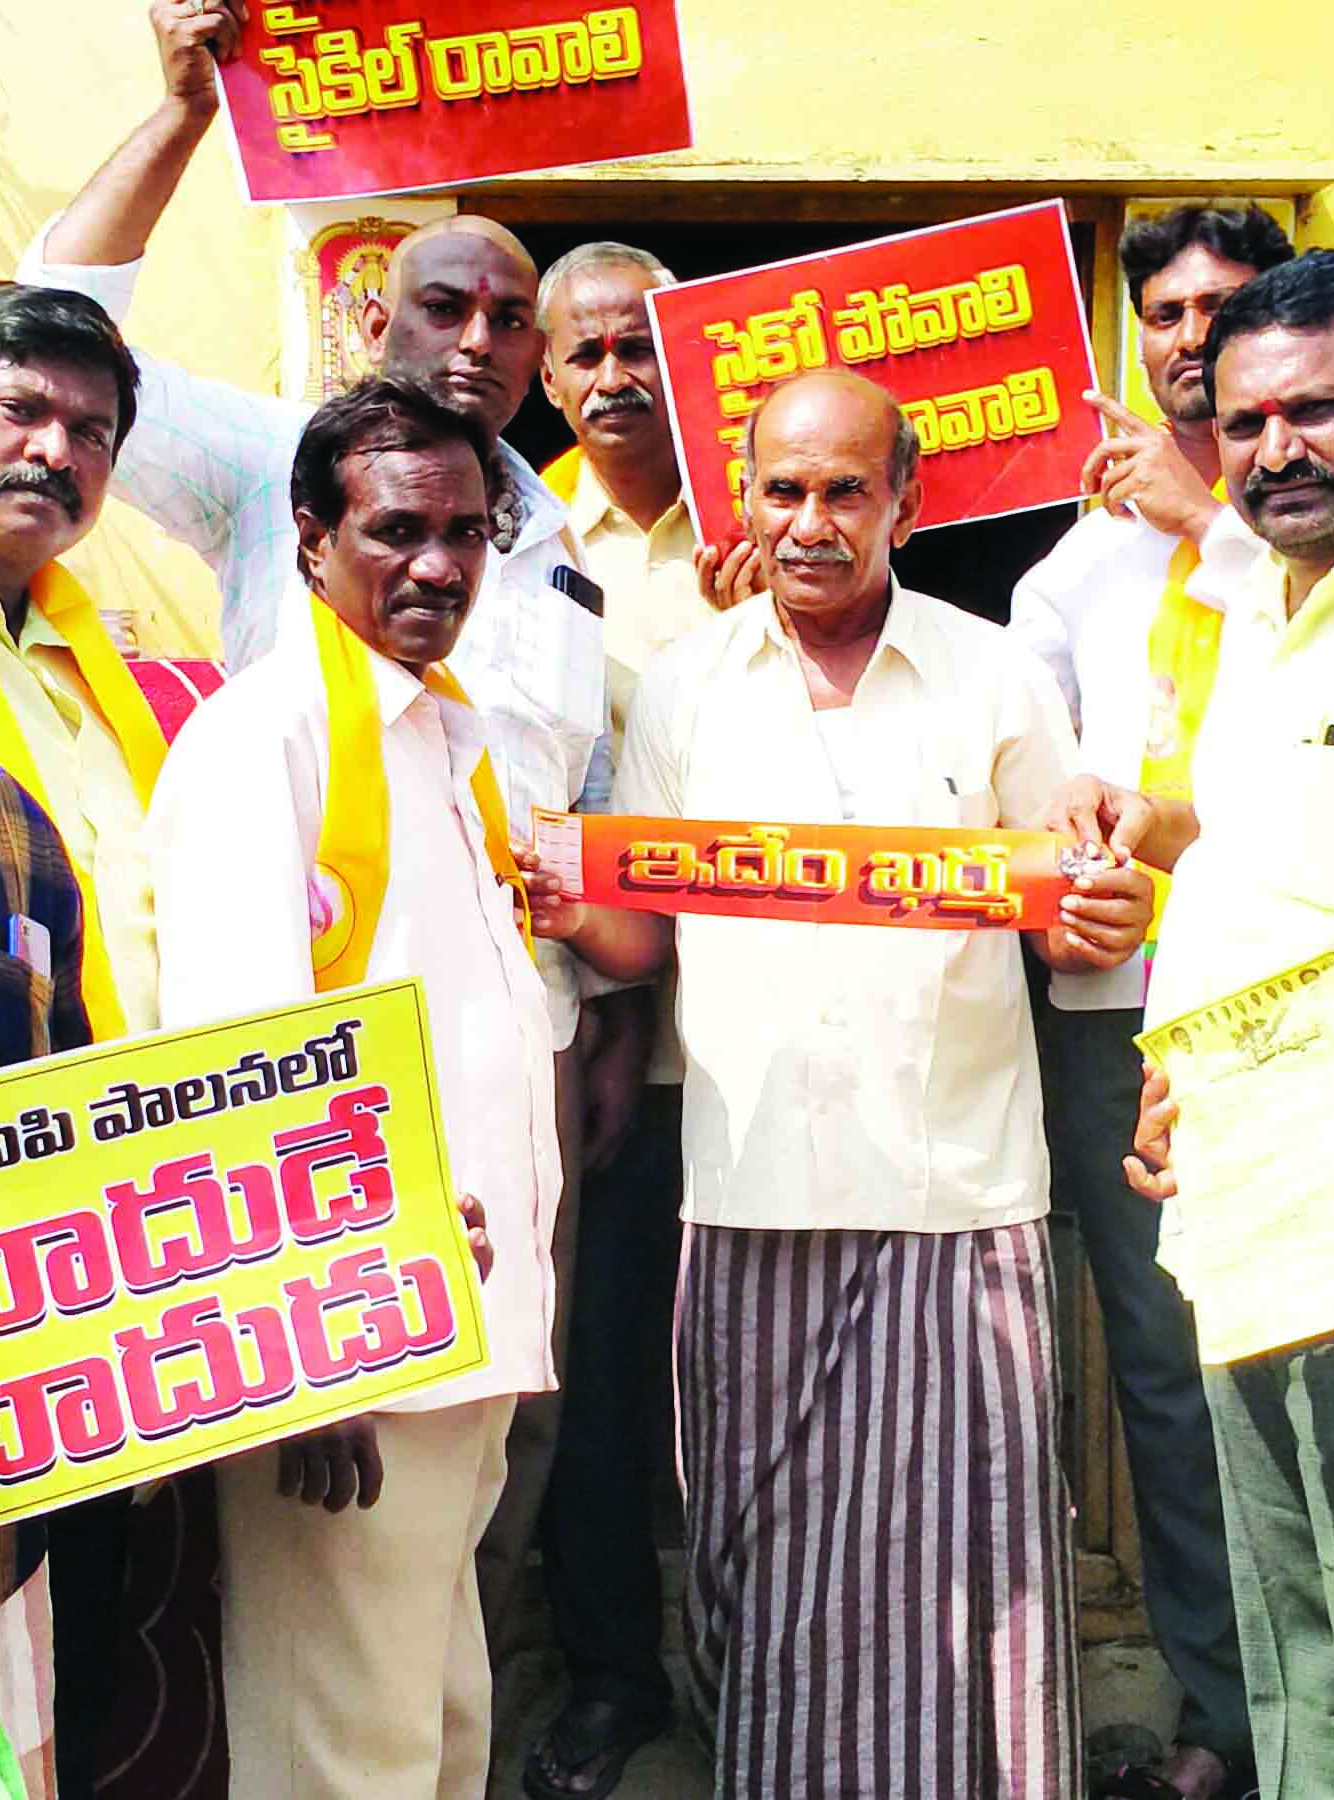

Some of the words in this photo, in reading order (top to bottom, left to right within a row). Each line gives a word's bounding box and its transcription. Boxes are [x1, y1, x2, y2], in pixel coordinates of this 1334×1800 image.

[261, 20, 424, 153] సైకిల్
[426, 6, 644, 100] రావాలి
[704, 289, 830, 418] సైకో
[833, 264, 1034, 365] పోవాలి
[620, 825, 848, 902] ఇదేం
[865, 843, 1022, 924] ఖర్మ
[90, 1019, 361, 1142] పాలనలో
